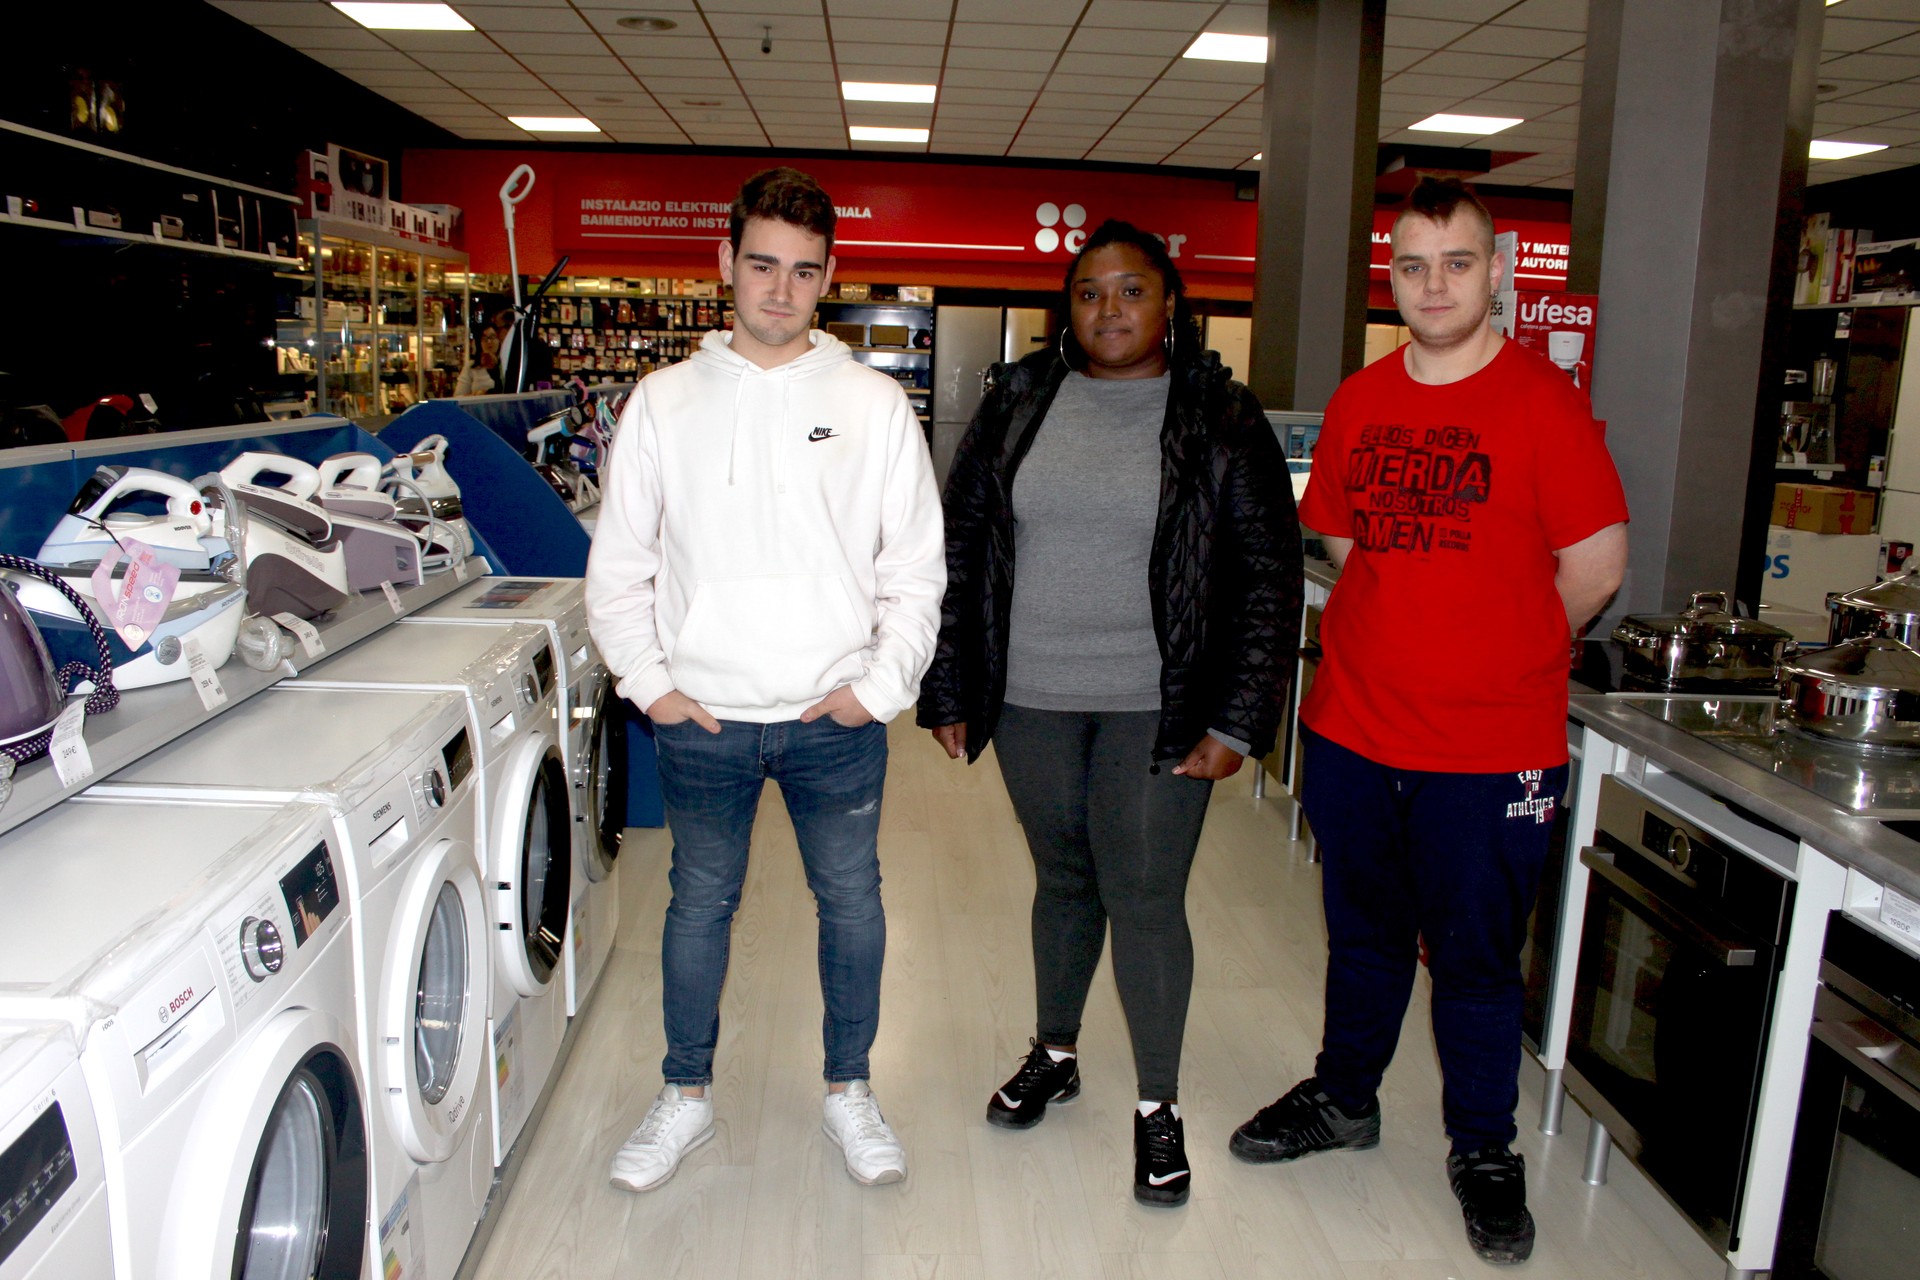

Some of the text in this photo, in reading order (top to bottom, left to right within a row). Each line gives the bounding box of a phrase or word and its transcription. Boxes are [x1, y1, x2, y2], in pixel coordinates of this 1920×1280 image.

[580, 199, 661, 211] INSTALAZIO
[580, 214, 688, 228] BAIMENDUTAKO
[1522, 242, 1531, 252] Y
[1520, 296, 1592, 325] ufesa
[813, 427, 832, 436] NIKE
[1369, 491, 1469, 519] NOSOTROS
[1517, 769, 1543, 784] EAST
[1506, 796, 1554, 818] ATHLETICS
[169, 986, 194, 1013] BOSCH
